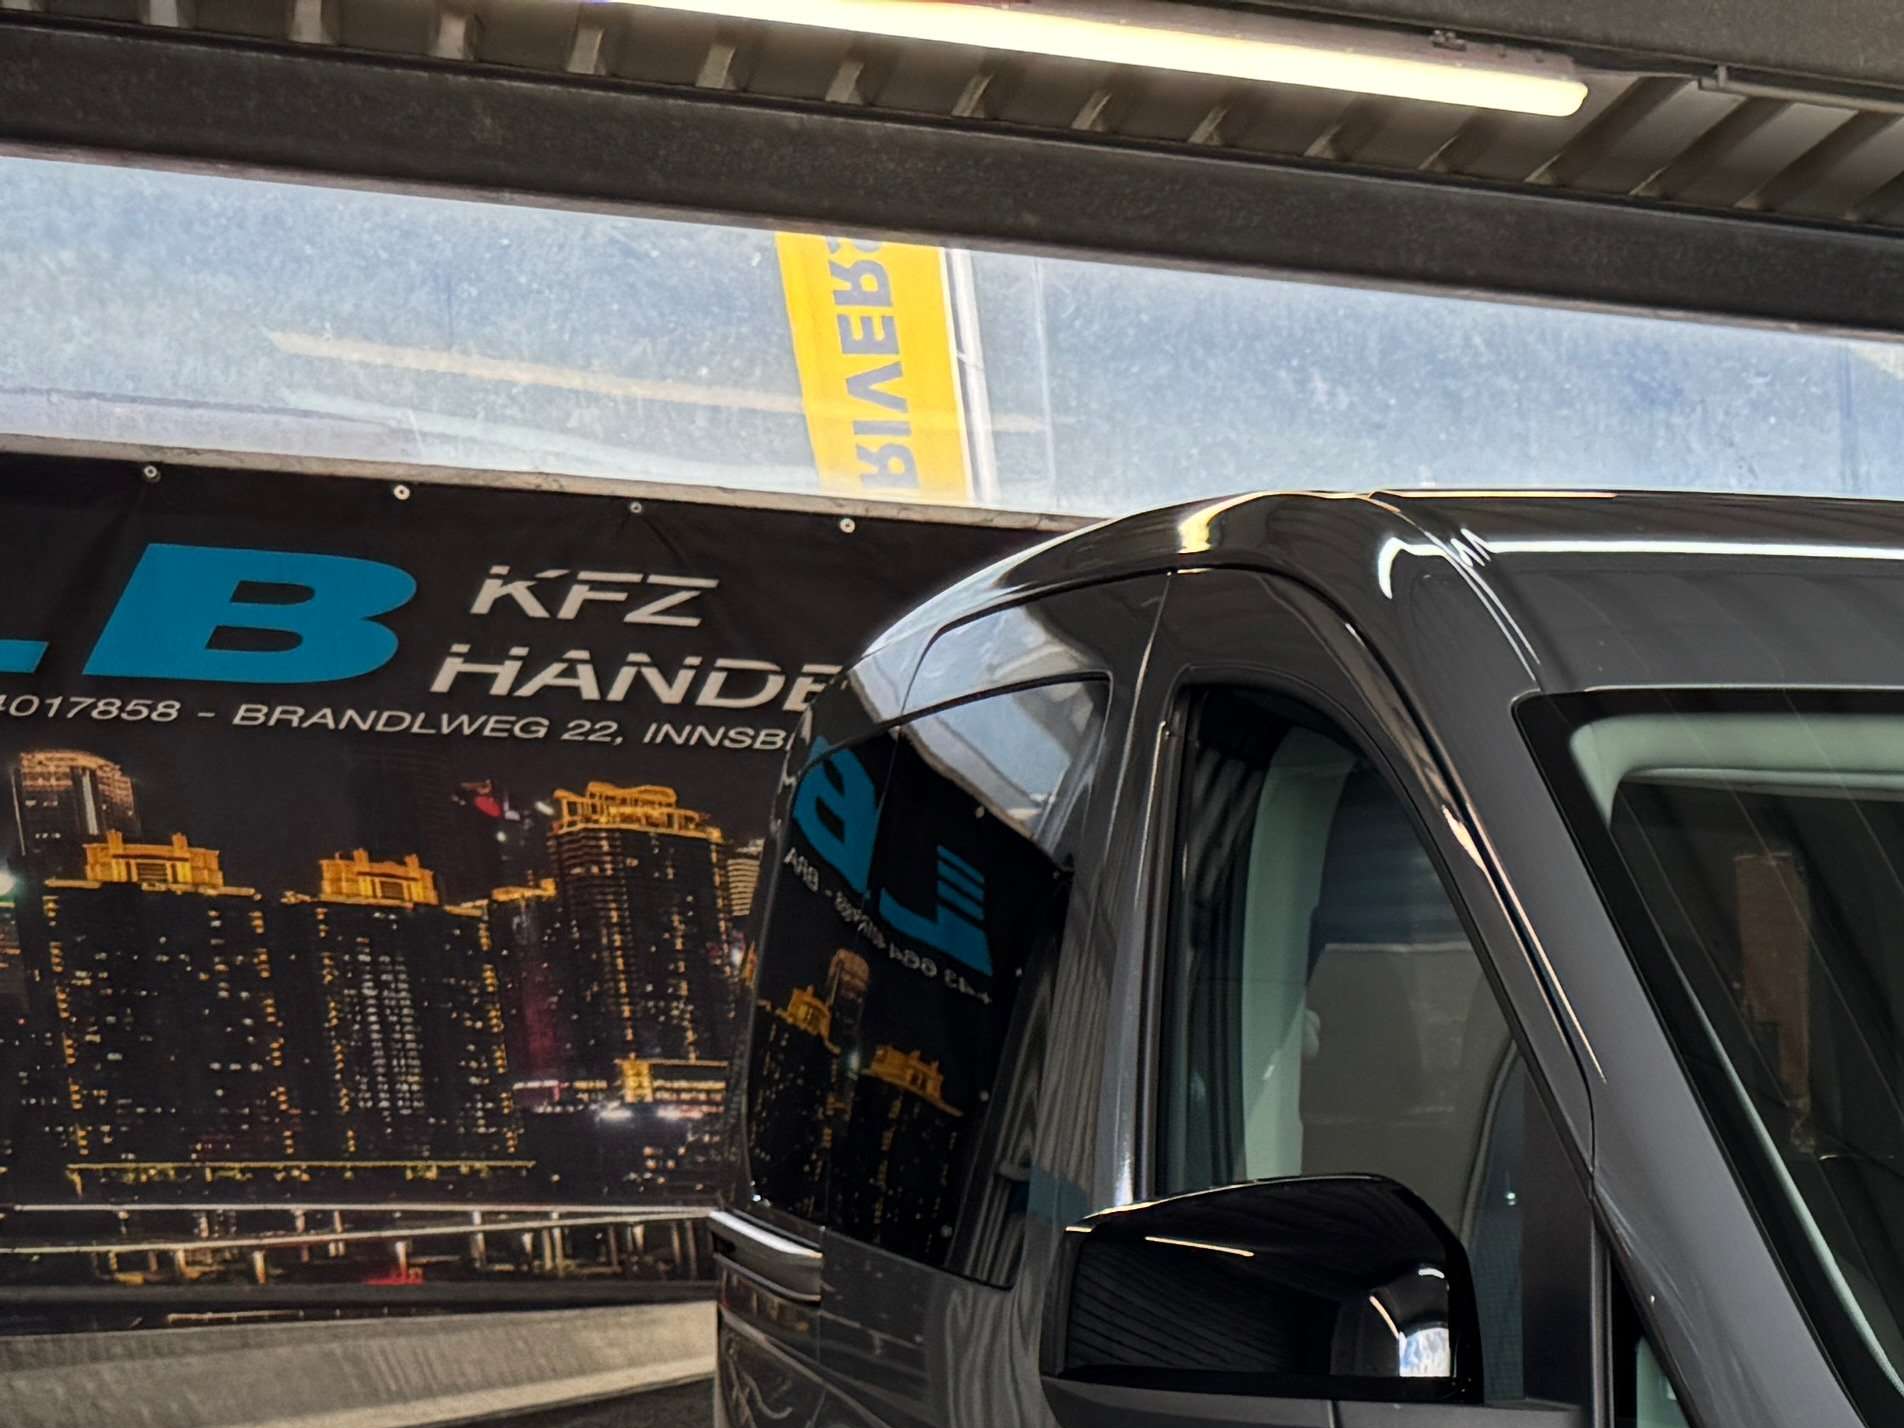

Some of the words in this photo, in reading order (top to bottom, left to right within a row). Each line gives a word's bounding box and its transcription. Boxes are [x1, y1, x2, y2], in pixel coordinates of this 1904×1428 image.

[468, 564, 719, 628] KFZ
[232, 704, 550, 739] BRANDLWEG
[560, 720, 624, 746] 22,
